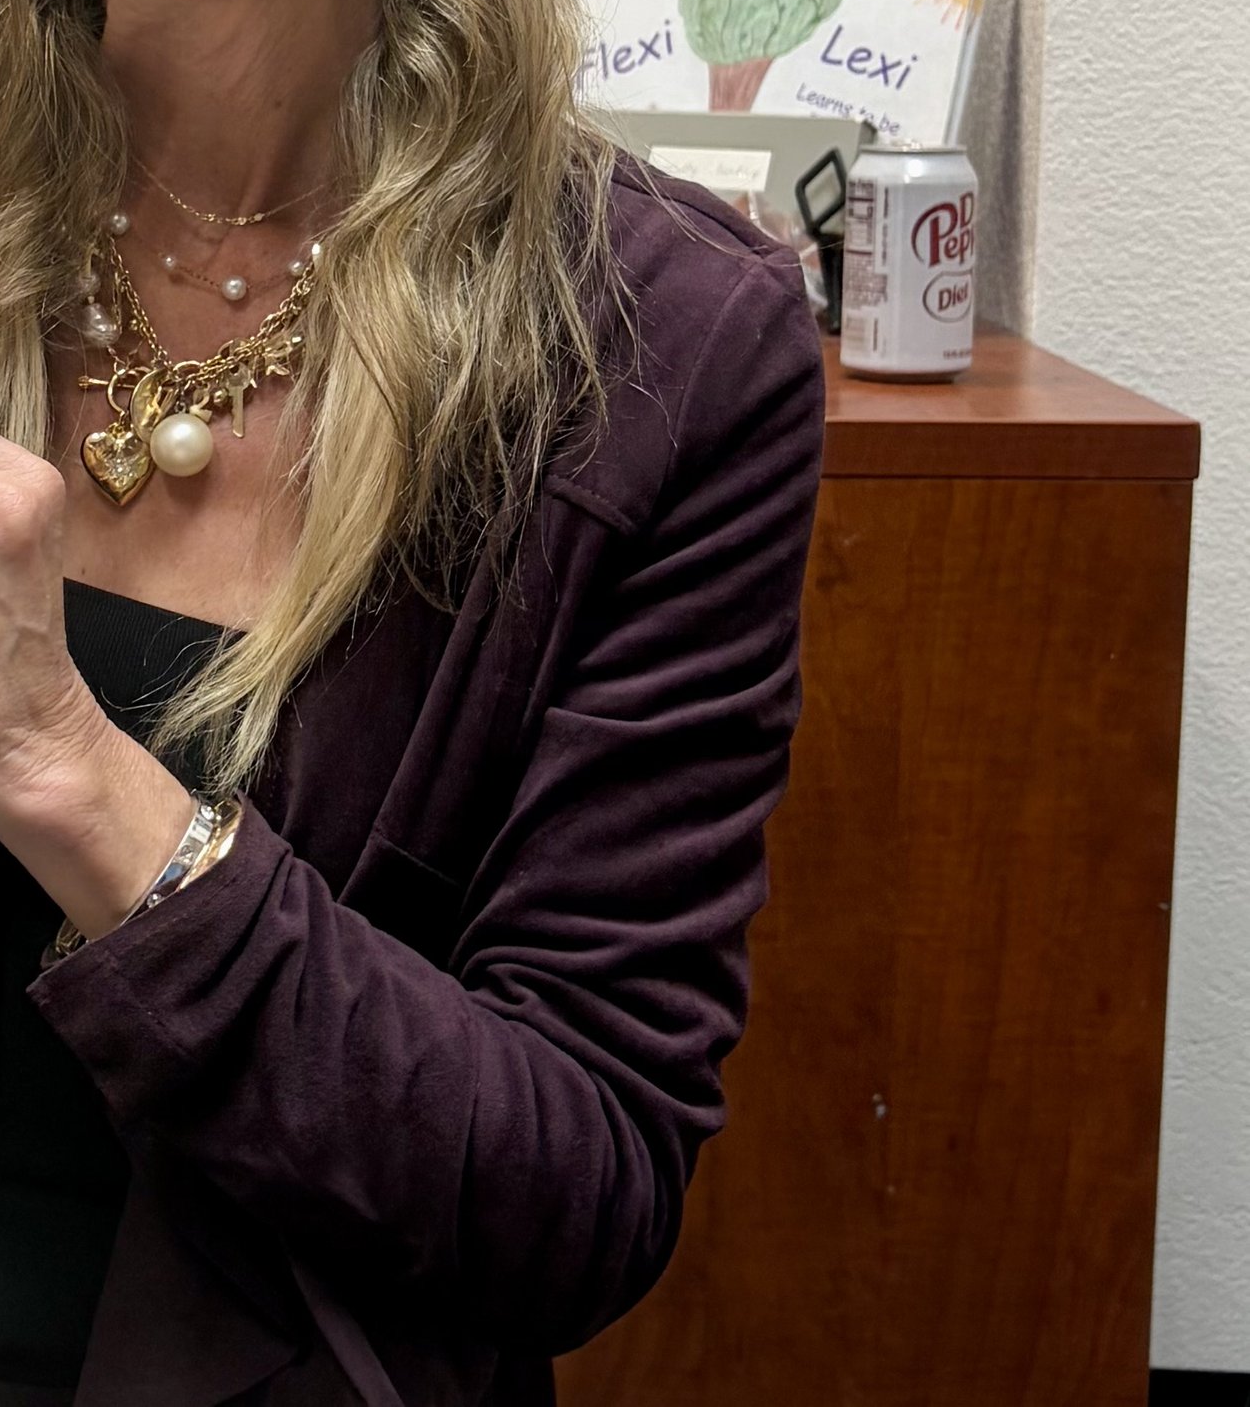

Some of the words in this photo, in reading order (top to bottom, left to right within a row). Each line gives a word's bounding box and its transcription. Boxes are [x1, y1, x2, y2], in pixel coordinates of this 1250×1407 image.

[820, 24, 919, 90] Lexi
[795, 82, 853, 119] Learns
[878, 111, 902, 137] be
